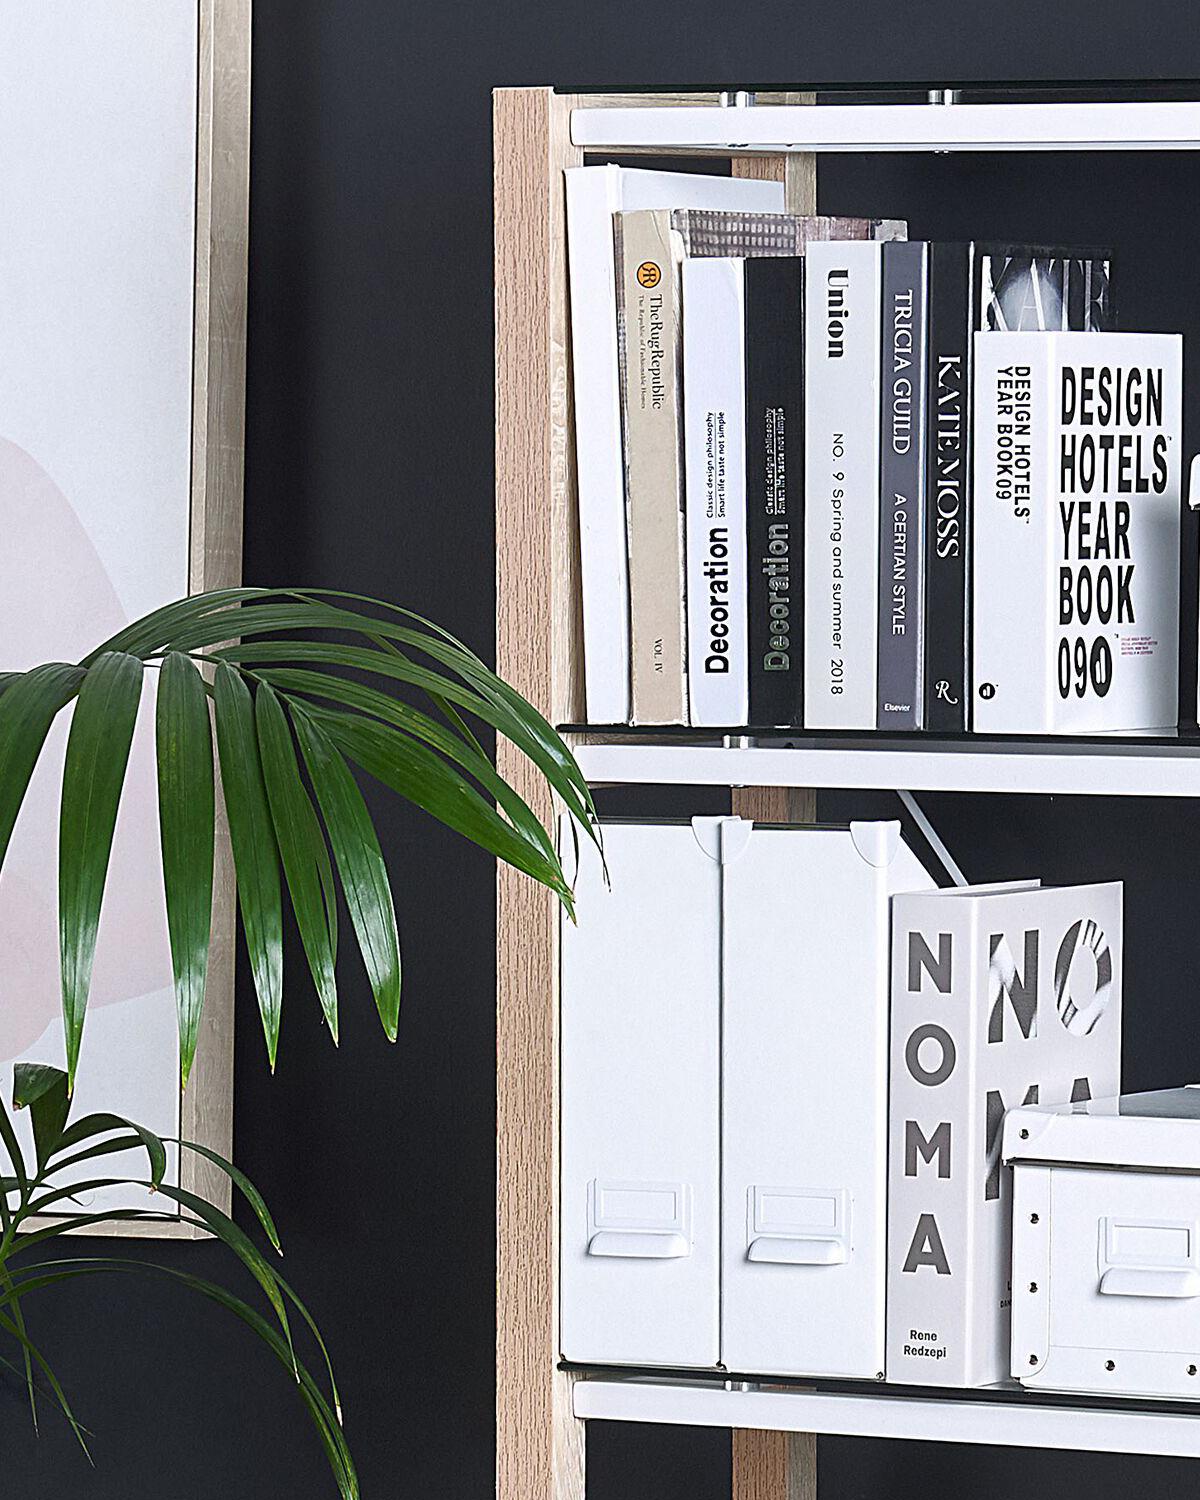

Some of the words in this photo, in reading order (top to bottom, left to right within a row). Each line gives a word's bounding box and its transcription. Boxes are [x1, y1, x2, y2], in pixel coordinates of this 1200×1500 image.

[827, 269, 849, 359] Union
[893, 289, 913, 373] TRICIA
[892, 378, 912, 455] GUILD
[937, 356, 961, 451] KATE
[997, 366, 1013, 416] YEAR
[1014, 366, 1031, 435] DESIGN
[1061, 366, 1163, 426] DESIGN
[705, 412, 714, 458] philosophy
[717, 411, 726, 438] simple
[833, 433, 844, 462] NO.
[705, 460, 714, 488] design
[717, 478, 725, 491] life
[832, 472, 844, 481] 9
[1014, 445, 1031, 518] HOTELS
[1060, 434, 1168, 494] HOTELS
[706, 490, 714, 518] Classic
[717, 493, 725, 518] Smart
[830, 489, 844, 542] Spring
[894, 494, 907, 506] A
[936, 457, 960, 558] MOSS
[893, 510, 907, 580] CERTIAN
[1059, 501, 1131, 560] YEAR
[832, 547, 844, 578] and
[703, 527, 729, 674] Decoration
[762, 523, 790, 671] Decoration
[831, 582, 844, 650] summer
[892, 585, 906, 635] STYLE
[1059, 565, 1135, 625] BOOK
[654, 663, 662, 673] IV
[830, 659, 844, 695] 2018
[903, 1345, 947, 1360] Redzepi
[910, 1329, 938, 1341] Rene
